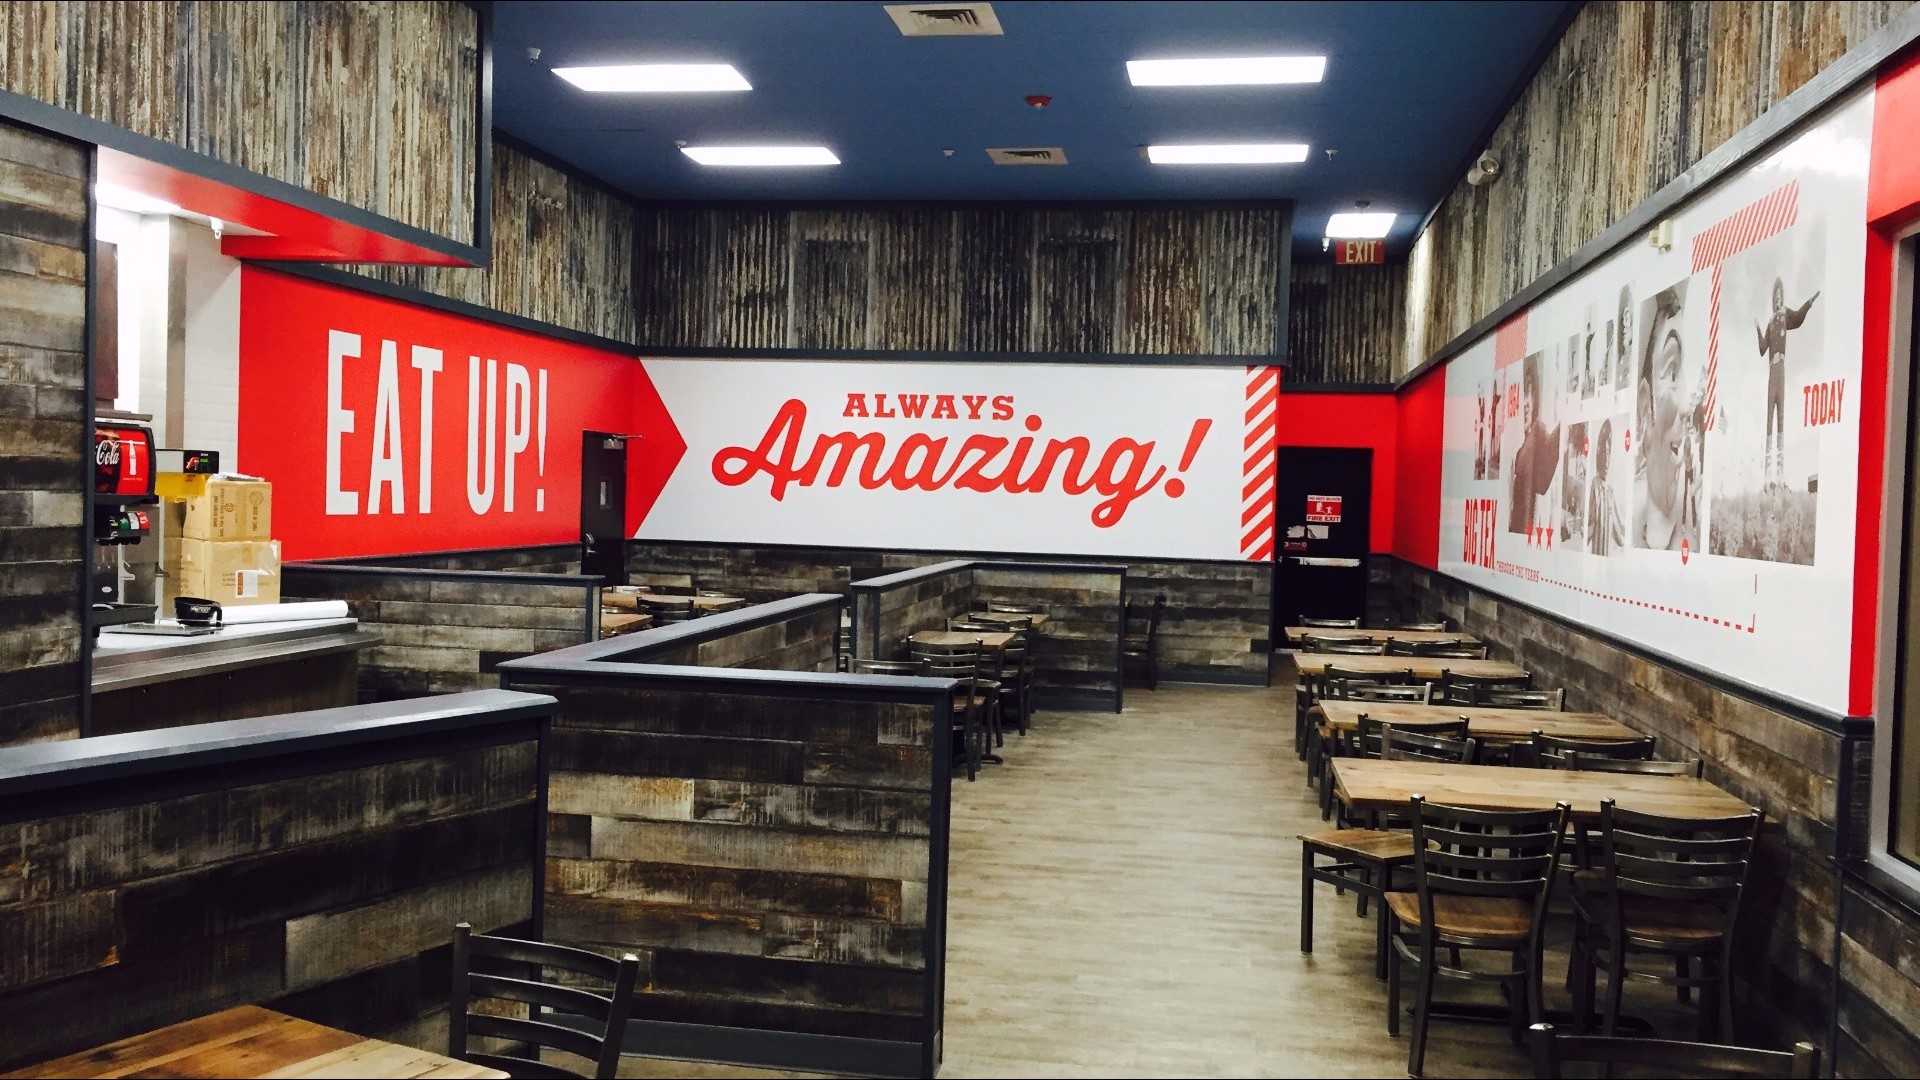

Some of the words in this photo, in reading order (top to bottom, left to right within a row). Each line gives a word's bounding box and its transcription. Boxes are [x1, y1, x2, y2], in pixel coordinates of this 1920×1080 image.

[1346, 240, 1377, 263] EXIT
[326, 329, 443, 515] EAT
[467, 355, 548, 515] UP!
[843, 393, 1015, 420] ALWAYS
[1804, 379, 1845, 427] TODAY
[711, 398, 1213, 528] Amazing!
[1463, 498, 1478, 566] BIG
[1480, 498, 1498, 570] TEX
